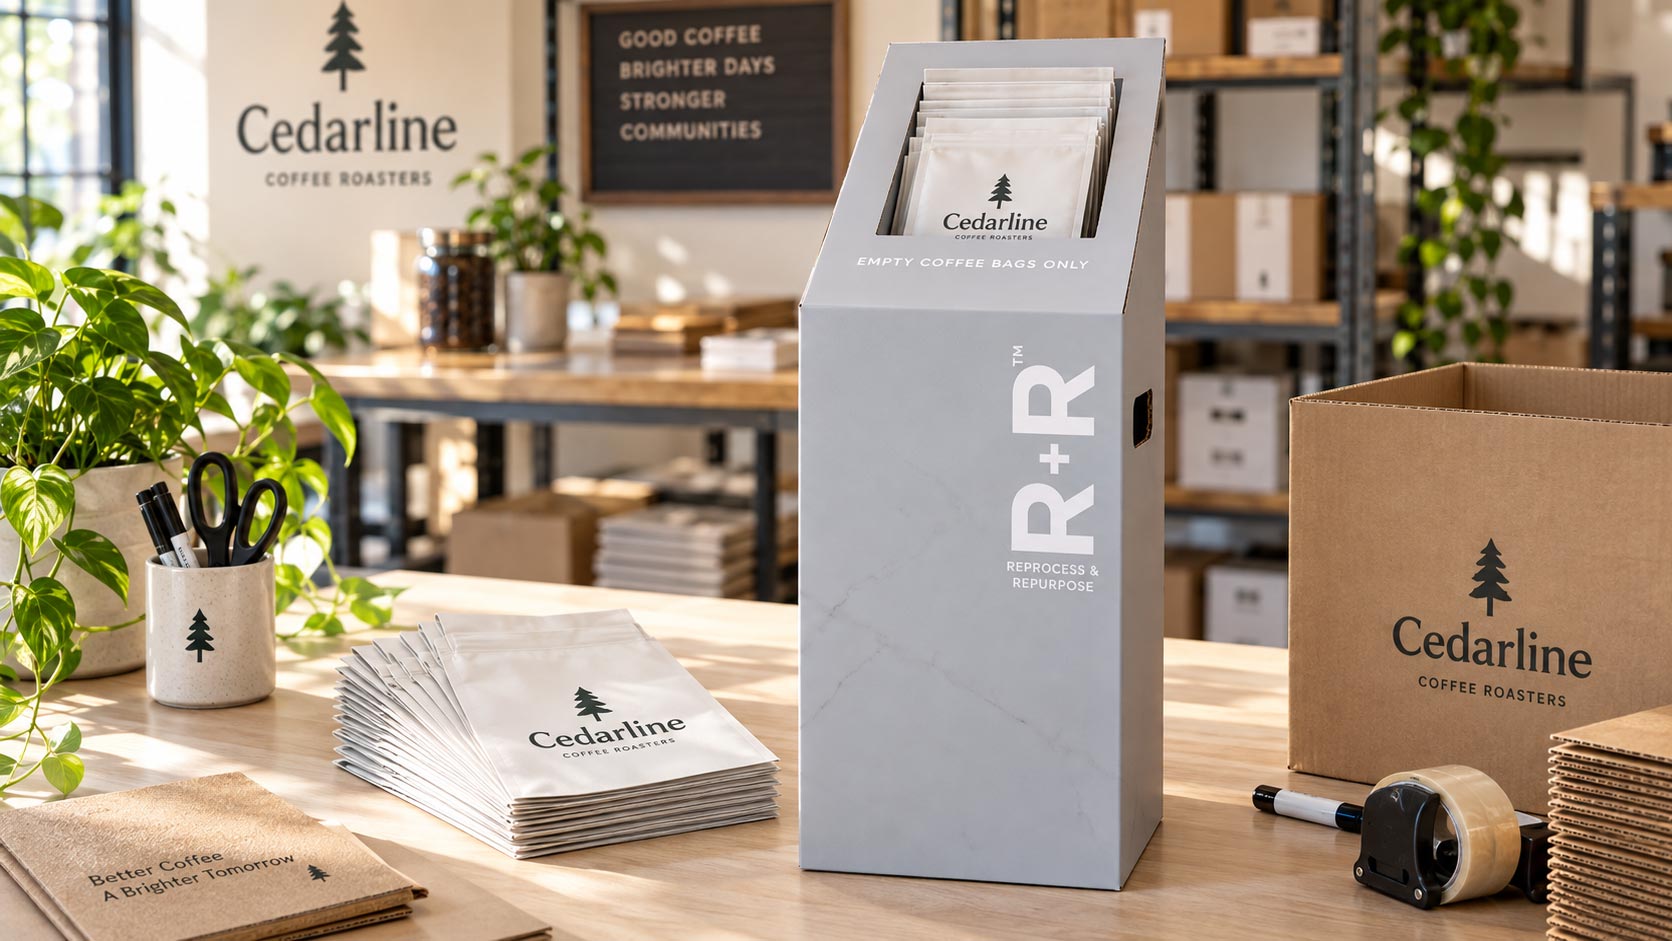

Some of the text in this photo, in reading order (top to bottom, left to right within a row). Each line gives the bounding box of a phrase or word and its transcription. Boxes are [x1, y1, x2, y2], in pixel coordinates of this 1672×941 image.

[619, 25, 761, 48] GOOD COFFEE
[619, 56, 775, 79] BRIGHTER DAYS
[620, 90, 726, 110] STRONGER
[237, 99, 458, 154] Cedarline
[619, 120, 763, 141] COMMUNITIES
[265, 171, 433, 187] COFFEE ROASTERS
[943, 212, 1048, 231] Cedarline
[857, 256, 1089, 270] EMPTY COFFEE BAGS ONLY
[1011, 364, 1095, 556] R+R
[1006, 561, 1100, 577] REPROCESS &
[1012, 577, 1095, 593] REPURPOSE
[1392, 615, 1593, 680] Cedarline
[1418, 675, 1566, 707] COFFEE ROASTERS
[528, 718, 687, 749] Cedarline
[562, 737, 676, 759] COFFEE ROASTERS
[88, 852, 224, 887] Better Coffee
[103, 855, 294, 902] A Brighter Tomorrow
